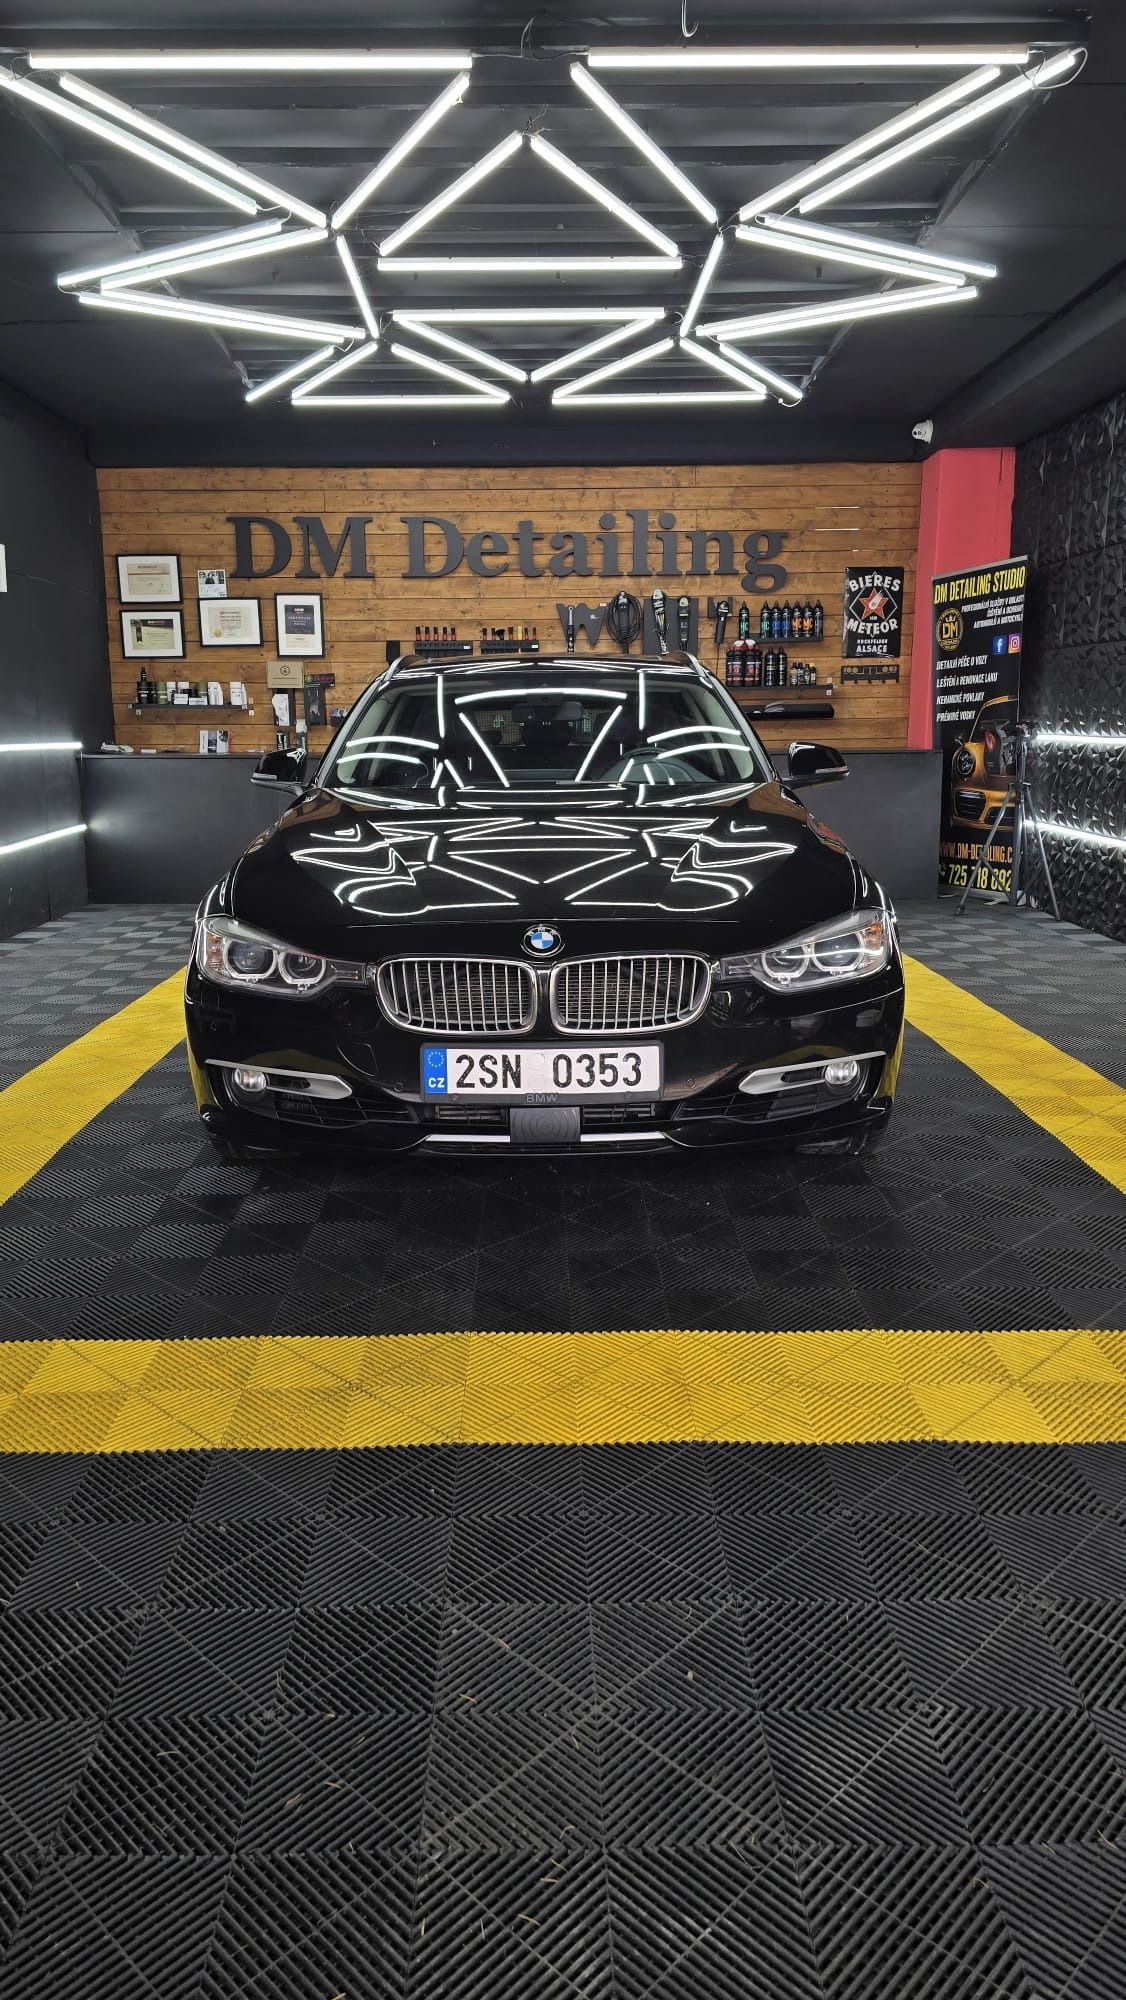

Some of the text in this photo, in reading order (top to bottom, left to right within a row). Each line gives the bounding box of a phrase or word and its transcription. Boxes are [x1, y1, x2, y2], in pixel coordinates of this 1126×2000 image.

[226, 509, 788, 593] DM Detailing
[848, 574, 901, 592] BIERES
[934, 566, 1026, 605] DM DETAILING STUDIO
[846, 618, 899, 635] METEOR
[942, 622, 958, 639] DM
[856, 645, 888, 653] ALSACE
[970, 657, 975, 666] O
[948, 863, 968, 886] 725
[455, 1052, 642, 1088] 2SN 0353
[428, 1078, 445, 1088] CZ
[526, 1093, 558, 1103] BMW
